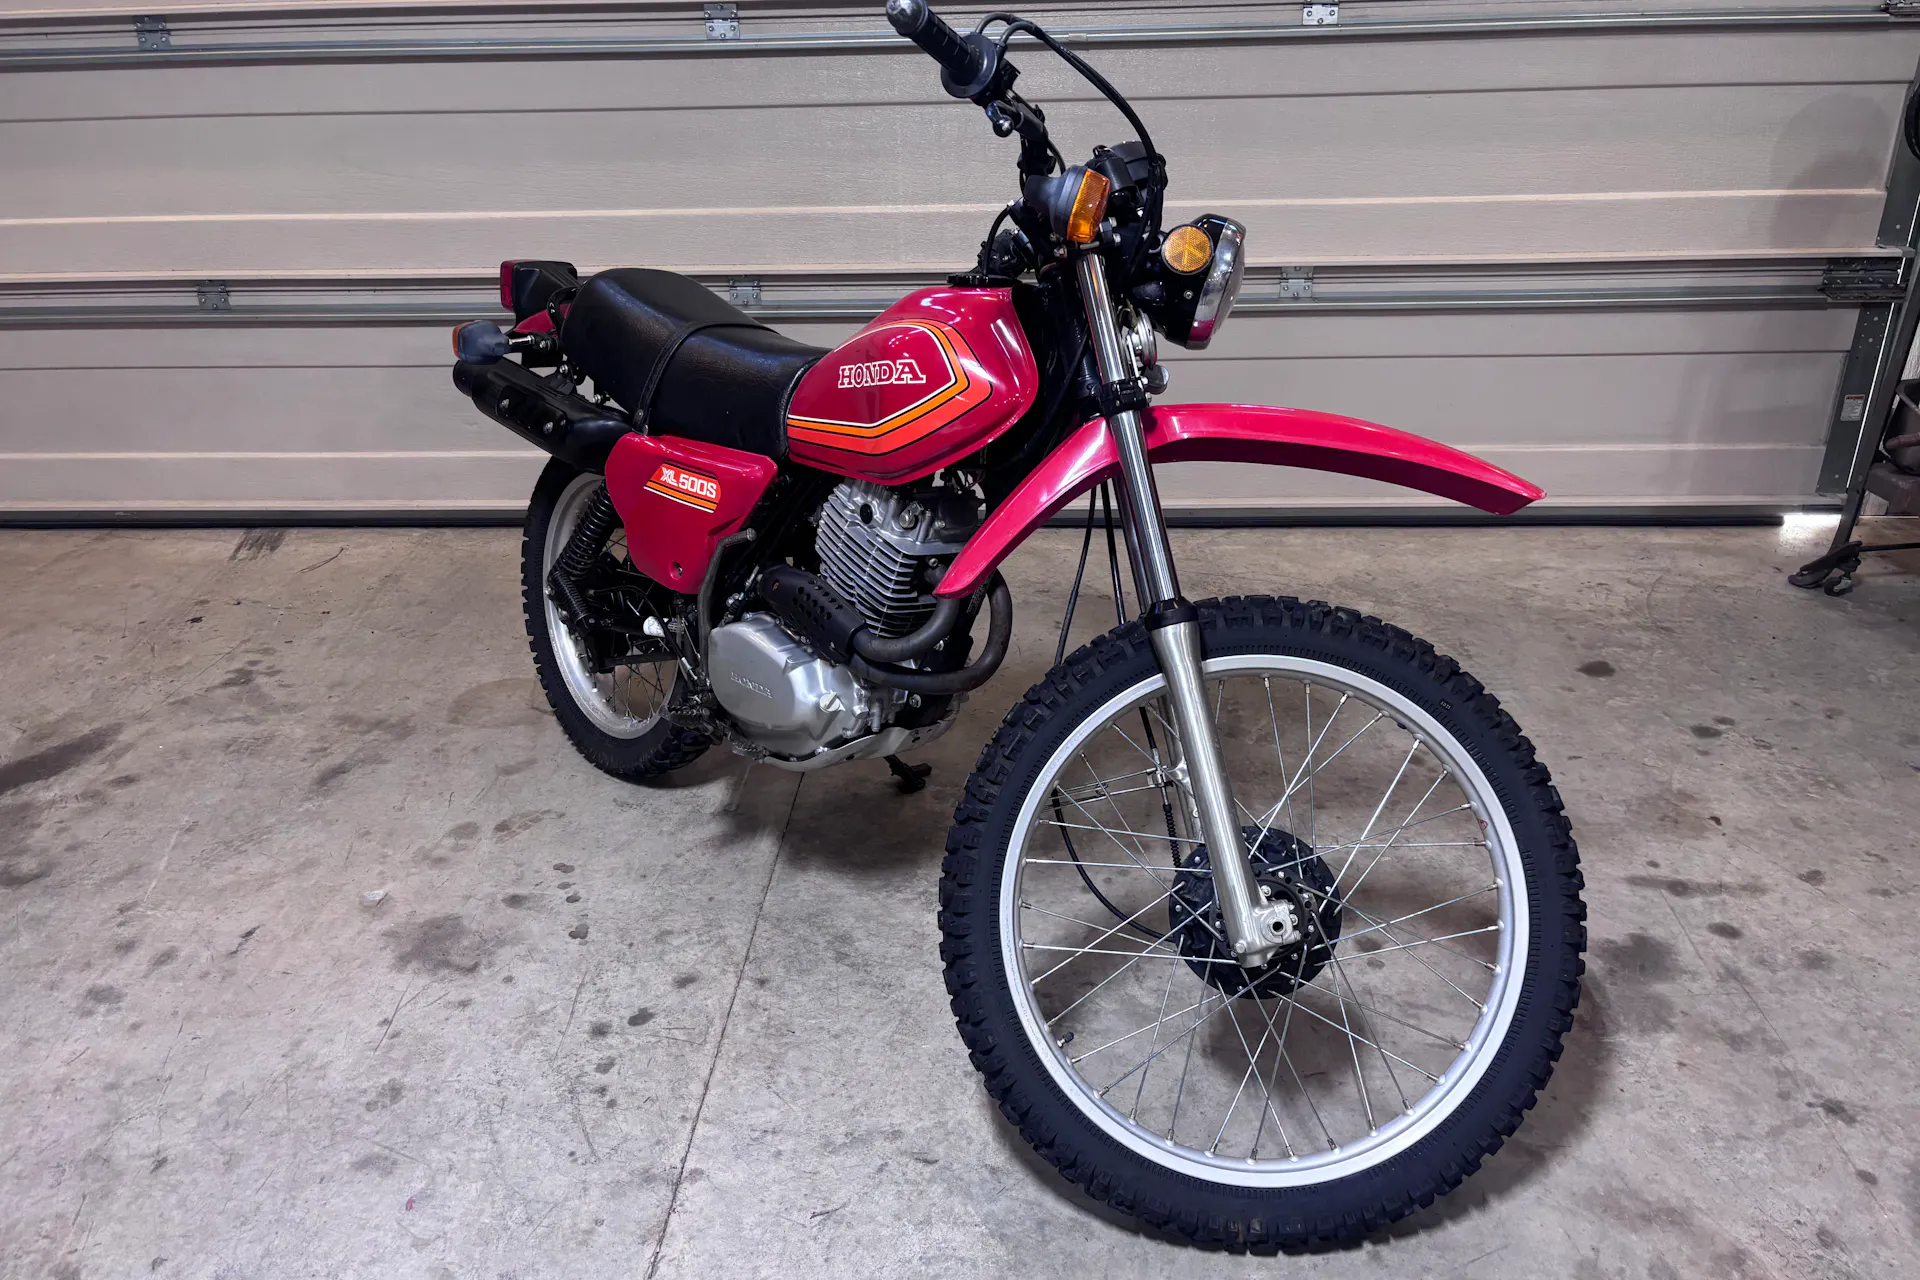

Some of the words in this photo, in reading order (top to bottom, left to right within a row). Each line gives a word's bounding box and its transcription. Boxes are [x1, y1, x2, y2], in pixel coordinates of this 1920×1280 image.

[838, 359, 926, 388] HONDA
[660, 466, 679, 487] XL
[678, 473, 717, 499] 500S
